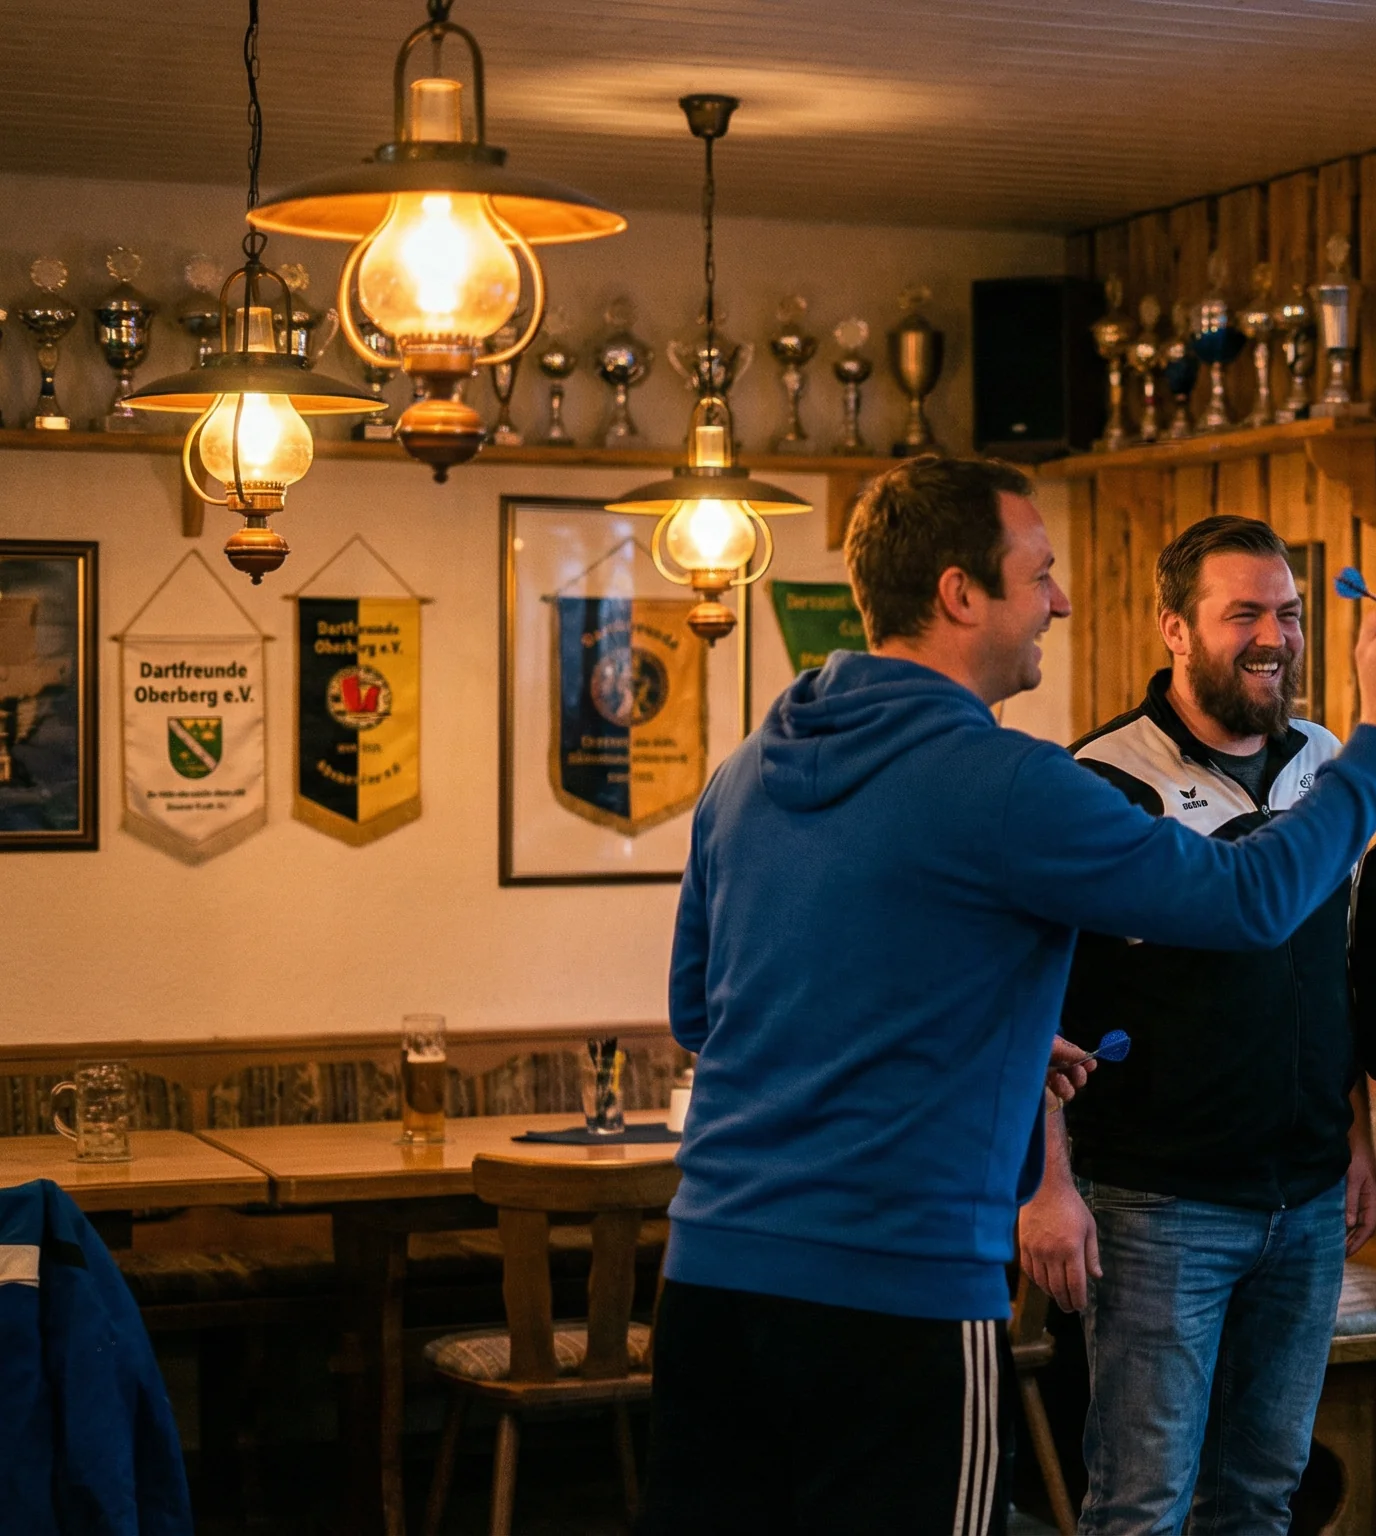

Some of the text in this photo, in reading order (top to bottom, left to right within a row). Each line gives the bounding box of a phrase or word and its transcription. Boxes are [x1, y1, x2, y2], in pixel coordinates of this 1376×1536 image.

[140, 661, 247, 679] Dartfreunde
[134, 686, 255, 708] Oberberg e.V.
